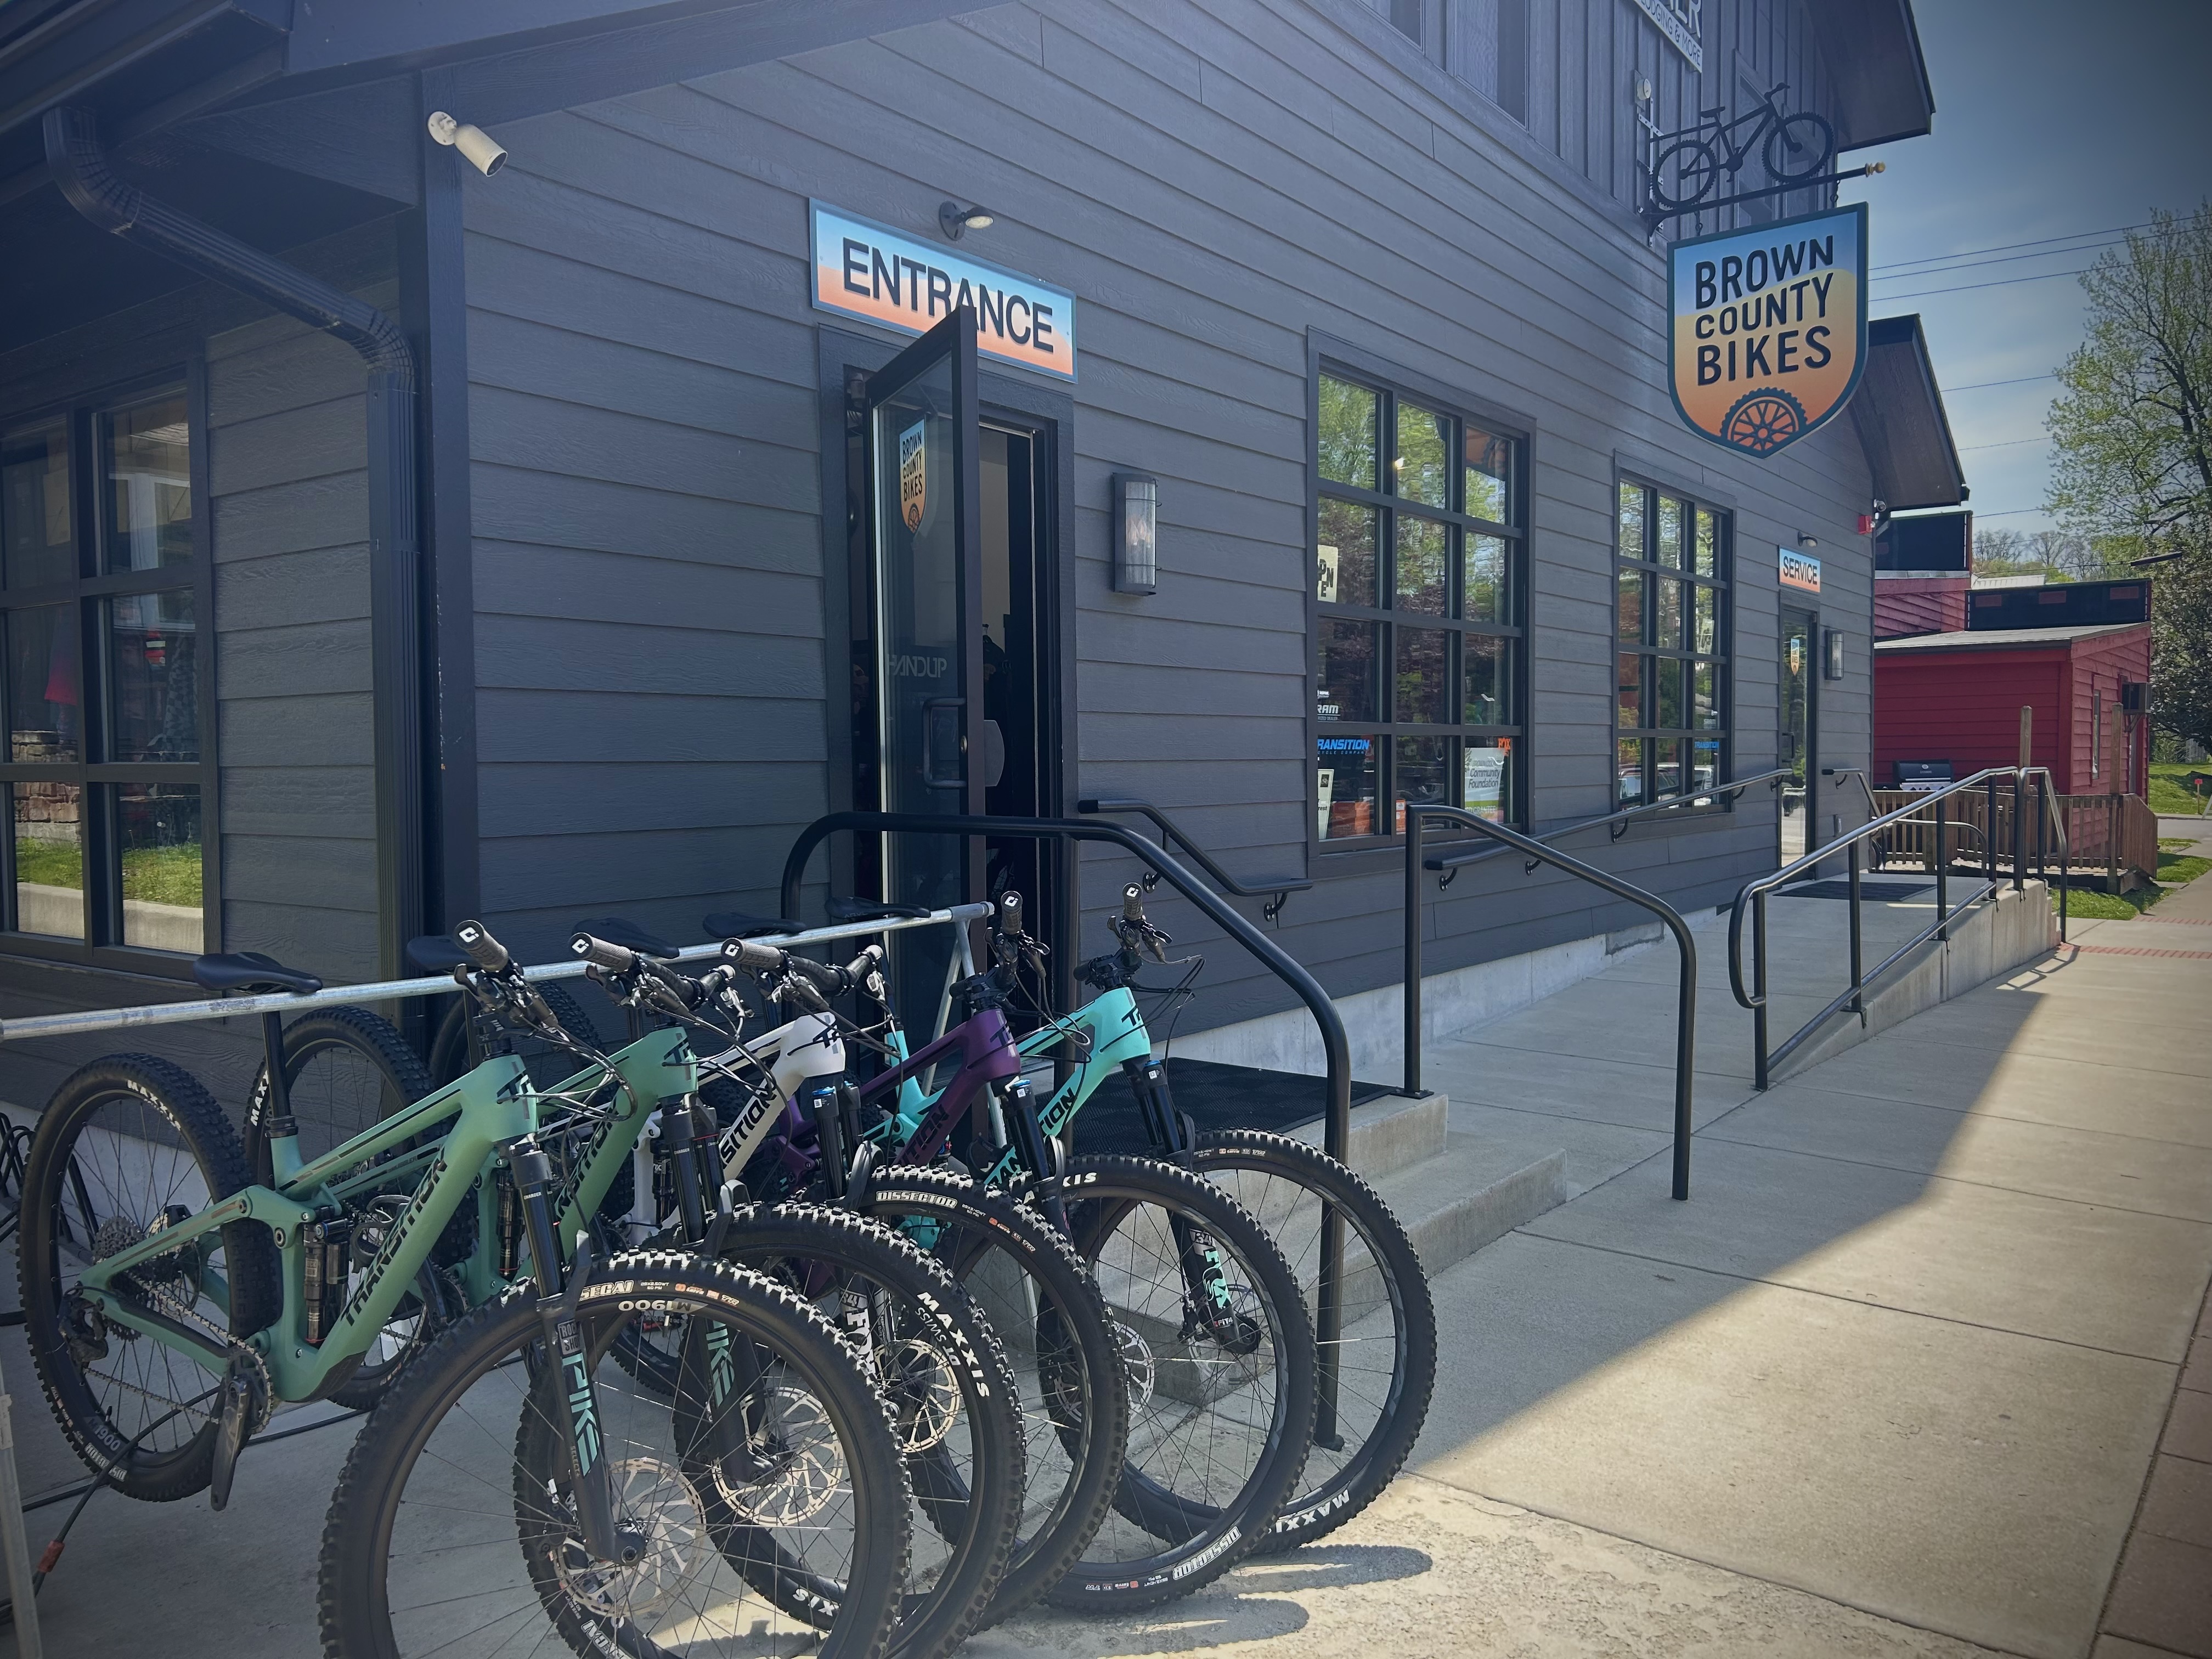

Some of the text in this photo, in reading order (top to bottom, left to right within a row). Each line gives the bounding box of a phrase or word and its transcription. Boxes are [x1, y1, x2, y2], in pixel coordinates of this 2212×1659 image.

[1675, 24, 1680, 42] &
[1683, 32, 1700, 66] MORE
[1696, 235, 1833, 309] BROWN
[843, 237, 1053, 353] ENTRANCE
[1695, 273, 1833, 339] COUNTY
[1697, 326, 1831, 386] BIKES
[902, 430, 922, 465] BROWN
[903, 448, 922, 479] COUNTY
[904, 473, 923, 502] BIKES
[1783, 556, 1818, 585] SERVICE
[1317, 704, 1339, 714] RAM
[1317, 738, 1370, 750] RANSITION
[1468, 778, 1498, 788] Foundation
[1470, 768, 1501, 779] Community
[251, 1070, 269, 1126] MAXX
[877, 1190, 958, 1209] DISSECTOR
[579, 1280, 634, 1302] SEGAI
[1203, 1250, 1232, 1309] FOX
[561, 1323, 577, 1338] ROC
[915, 1307, 947, 1342] SWISS
[564, 1337, 579, 1351] SHO
[917, 1292, 990, 1397] MAXXIS
[1268, 1489, 1350, 1534] MAXXI
[1172, 1526, 1242, 1580] DISSECTOR
